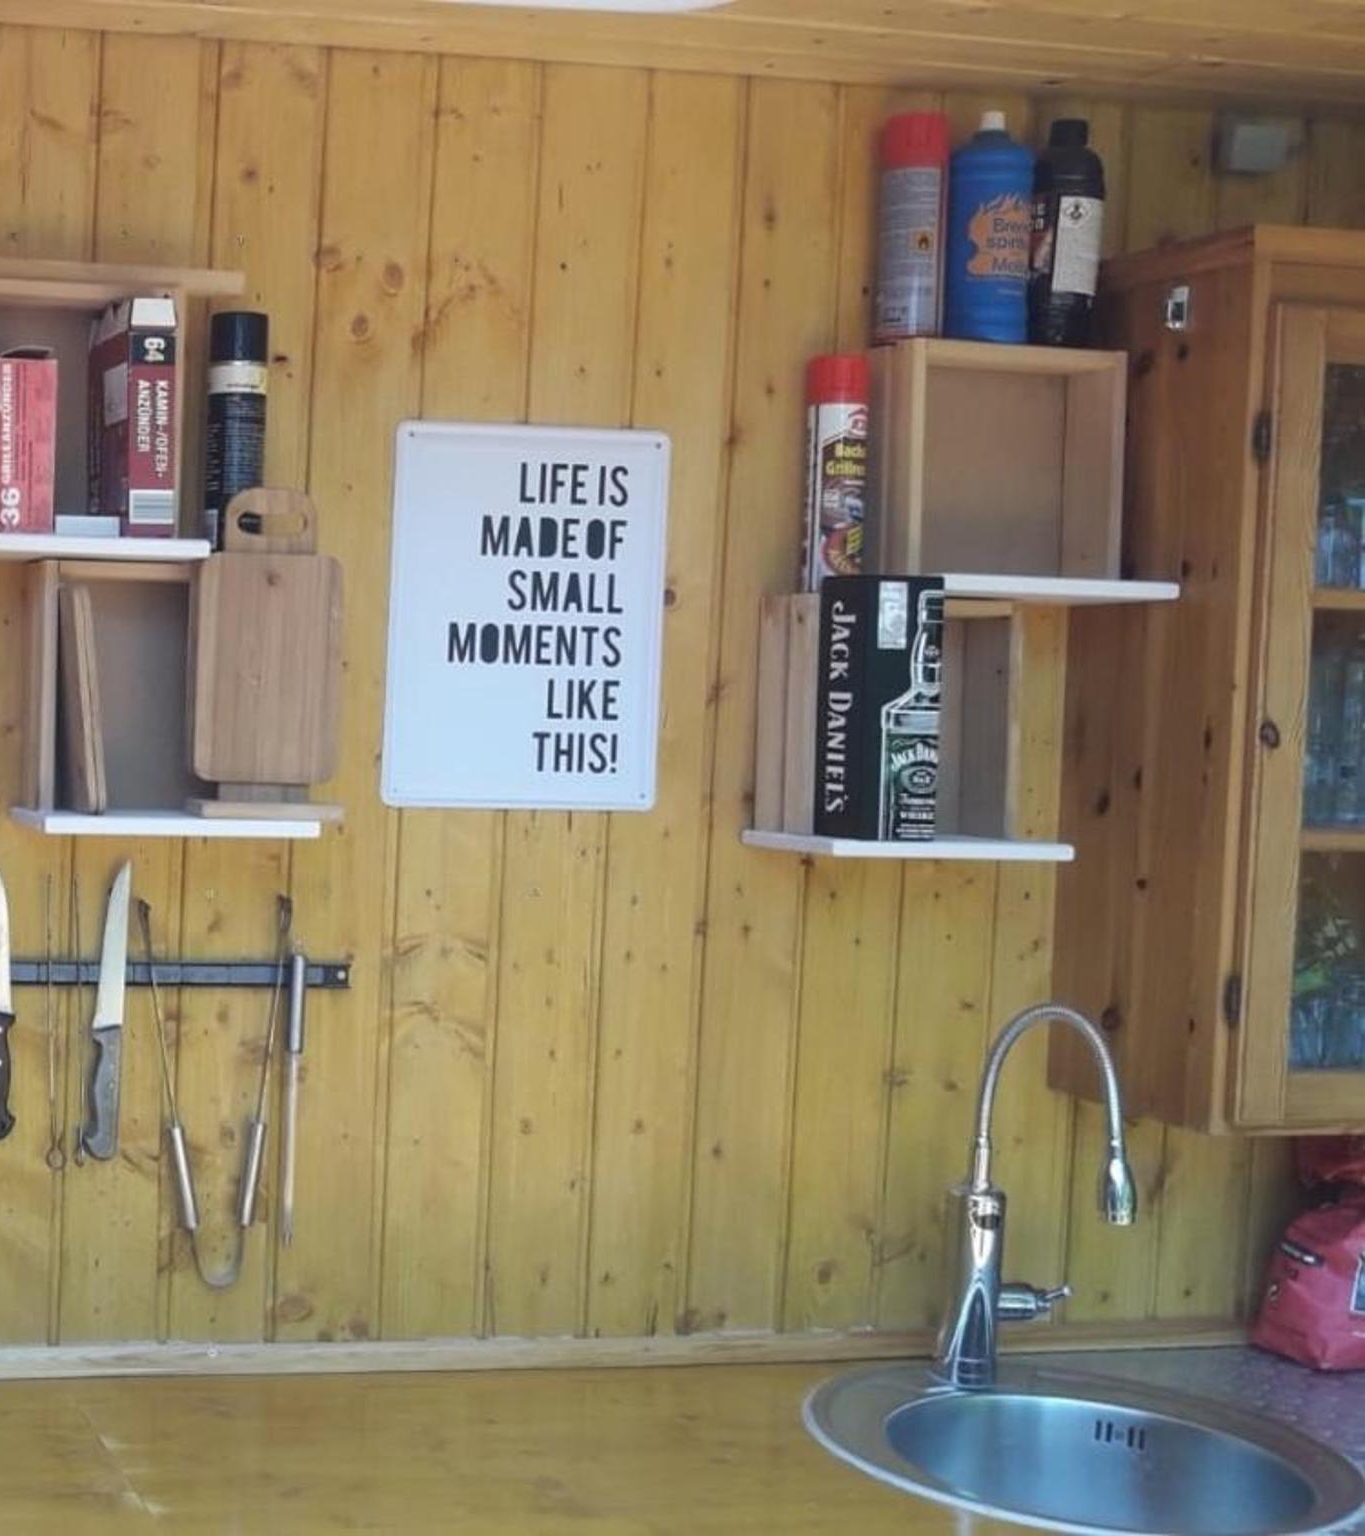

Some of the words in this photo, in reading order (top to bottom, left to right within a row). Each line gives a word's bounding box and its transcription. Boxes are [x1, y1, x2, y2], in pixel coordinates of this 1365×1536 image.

[143, 337, 166, 362] 64
[1, 363, 13, 485] GRILLANZÜNDER
[137, 379, 151, 454] ANZÜNDER
[0, 486, 22, 526] 36
[519, 462, 589, 505] LIFE
[598, 466, 630, 507] IS
[480, 515, 580, 559] MADE
[585, 518, 628, 561] OF
[507, 569, 623, 615] SMALL
[447, 622, 622, 668] MOMENTS
[829, 601, 856, 680] JACK
[546, 678, 620, 721] LIKE
[533, 732, 618, 774] THIS!
[824, 691, 853, 812] DANIEL'S
